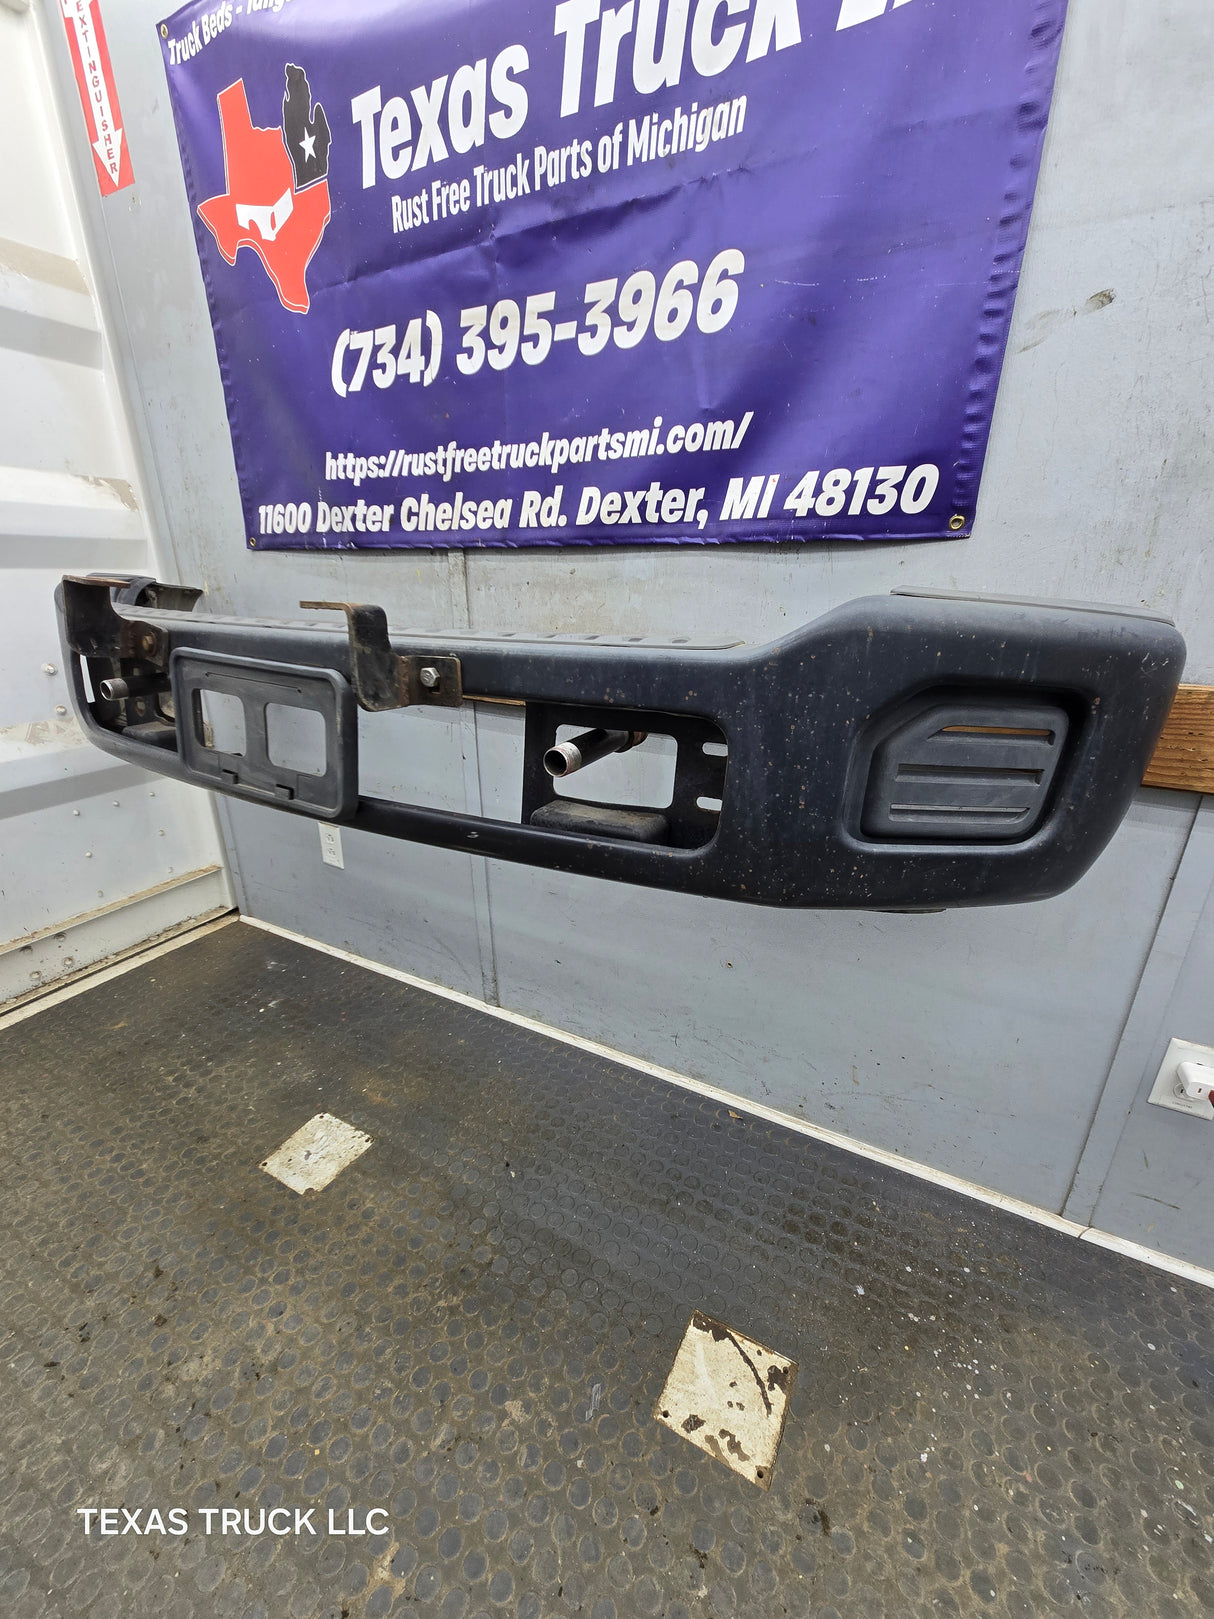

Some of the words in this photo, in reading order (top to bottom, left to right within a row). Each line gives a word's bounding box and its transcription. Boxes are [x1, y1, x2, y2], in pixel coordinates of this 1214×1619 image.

[75, 0, 118, 174] EXTINGUISHER
[168, 20, 203, 65] Truck
[201, 1, 233, 45] Beds
[351, 44, 530, 190] Texas
[554, 0, 802, 118] Truck
[392, 188, 430, 233] Rust
[432, 178, 470, 221] Free
[474, 153, 531, 209] Truck
[534, 139, 593, 191] Parts
[597, 123, 623, 173] of
[627, 94, 748, 167] Michigan
[331, 310, 443, 398] (734)
[456, 248, 746, 375] 395-3966
[258, 502, 312, 534] 11600
[316, 499, 395, 534] Dexter
[401, 491, 513, 532] Chelsea
[519, 485, 568, 529] Rd.
[575, 481, 706, 530] Dexter,
[719, 473, 780, 521] MI
[783, 463, 940, 516] 48130
[325, 411, 754, 486] https://rustfreetruckpartsmi.com/
